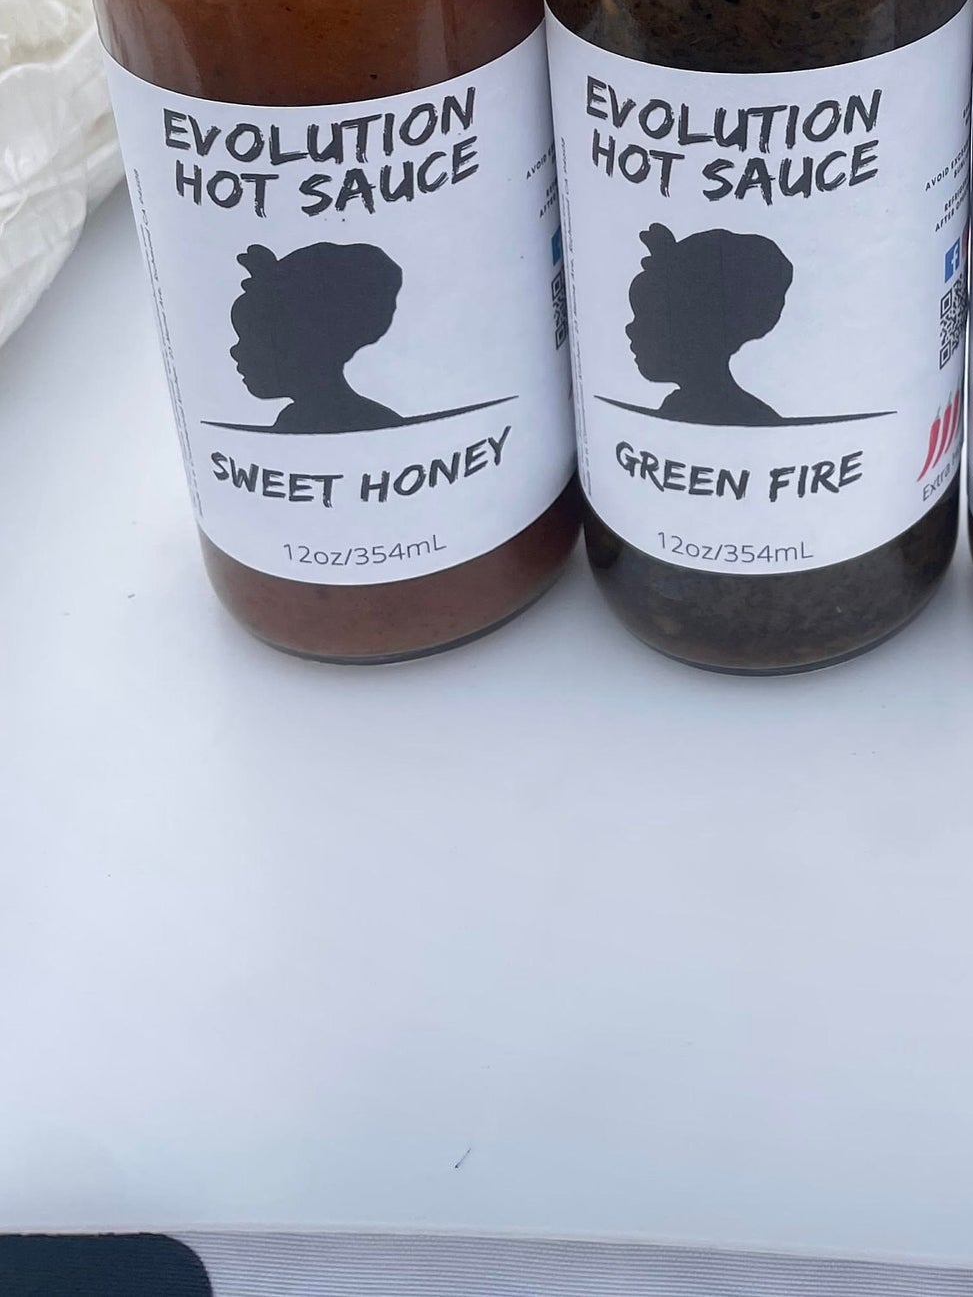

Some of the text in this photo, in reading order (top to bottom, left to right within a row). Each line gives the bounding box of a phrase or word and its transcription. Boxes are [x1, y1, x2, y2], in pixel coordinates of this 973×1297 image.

[163, 86, 477, 166] EVOLUTION
[585, 75, 882, 153] EVOLUTION
[175, 136, 480, 218] HOT SAUCE
[591, 128, 685, 199] HOT
[702, 140, 880, 206] SAUCE
[210, 425, 512, 508] SWEET HONEY
[615, 440, 864, 503] GREEN FIRE
[922, 462, 951, 502] Extra
[283, 533, 447, 568] 12oz/354mL
[656, 531, 814, 564] 12oz/354mL
